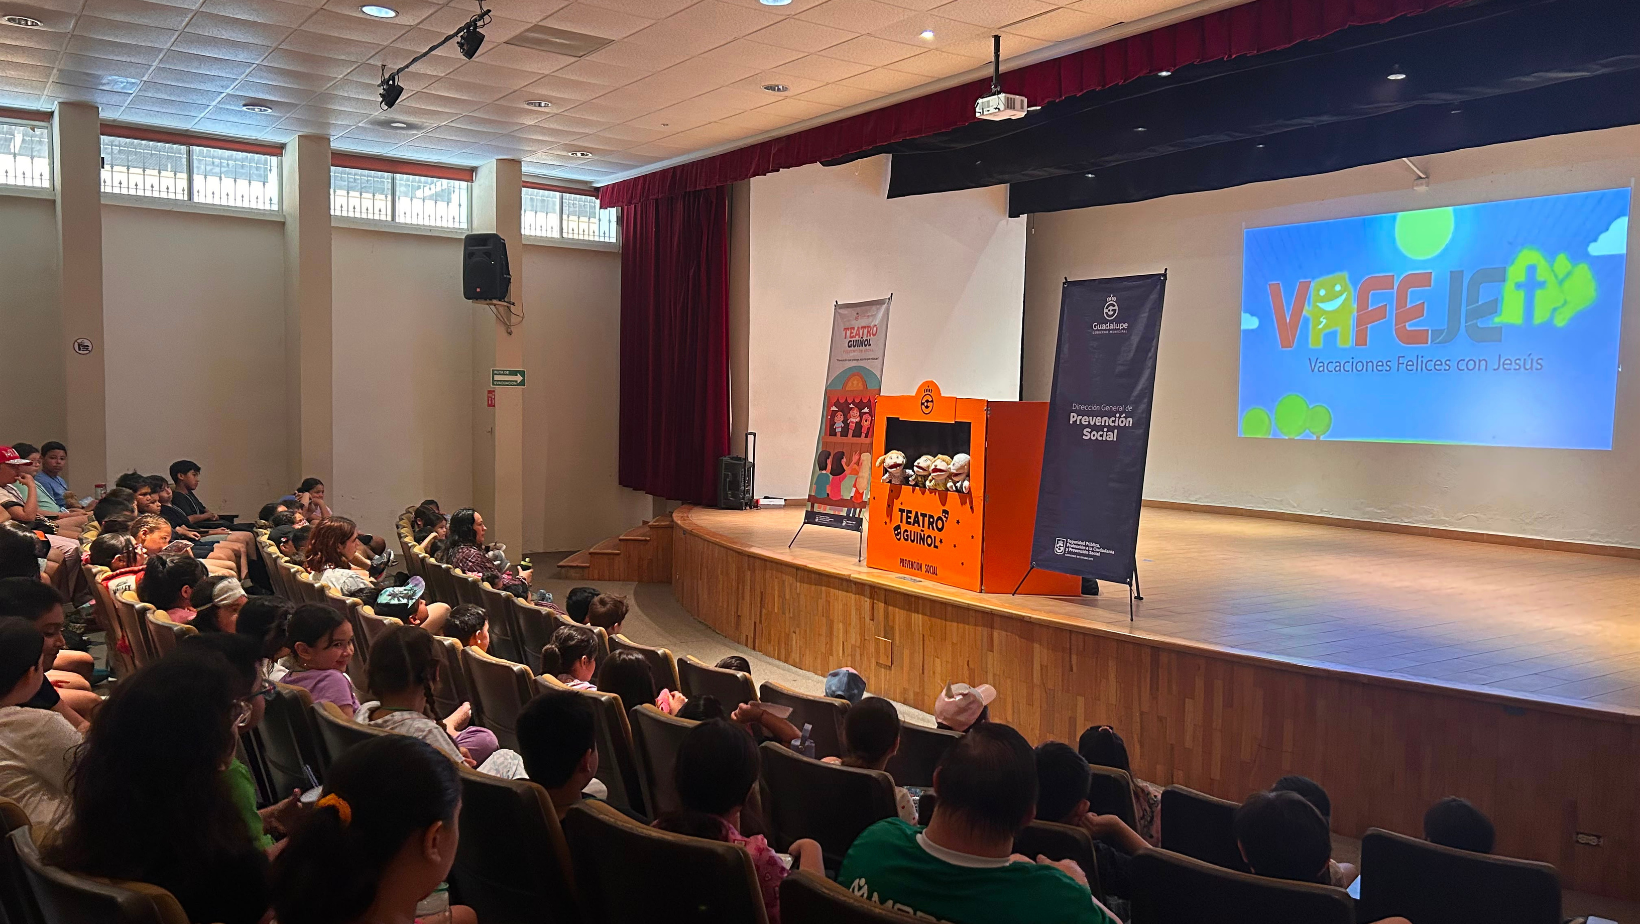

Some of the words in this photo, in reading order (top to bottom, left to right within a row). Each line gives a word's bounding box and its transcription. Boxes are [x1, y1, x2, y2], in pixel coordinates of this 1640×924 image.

[843, 324, 878, 339] TEATRO
[1092, 322, 1128, 330] Guadalupe
[847, 337, 872, 348] GUIÑOL
[1308, 356, 1392, 373] Vacaciones
[1396, 354, 1451, 372] Felices
[1456, 357, 1488, 371] con
[1493, 353, 1544, 372] Jesús
[1072, 403, 1100, 411] Dirección
[1100, 404, 1125, 412] General
[1069, 412, 1133, 427] Prevención
[1082, 427, 1118, 441] Social
[898, 508, 945, 532] TEATRO
[902, 529, 939, 549] GUIÑOL
